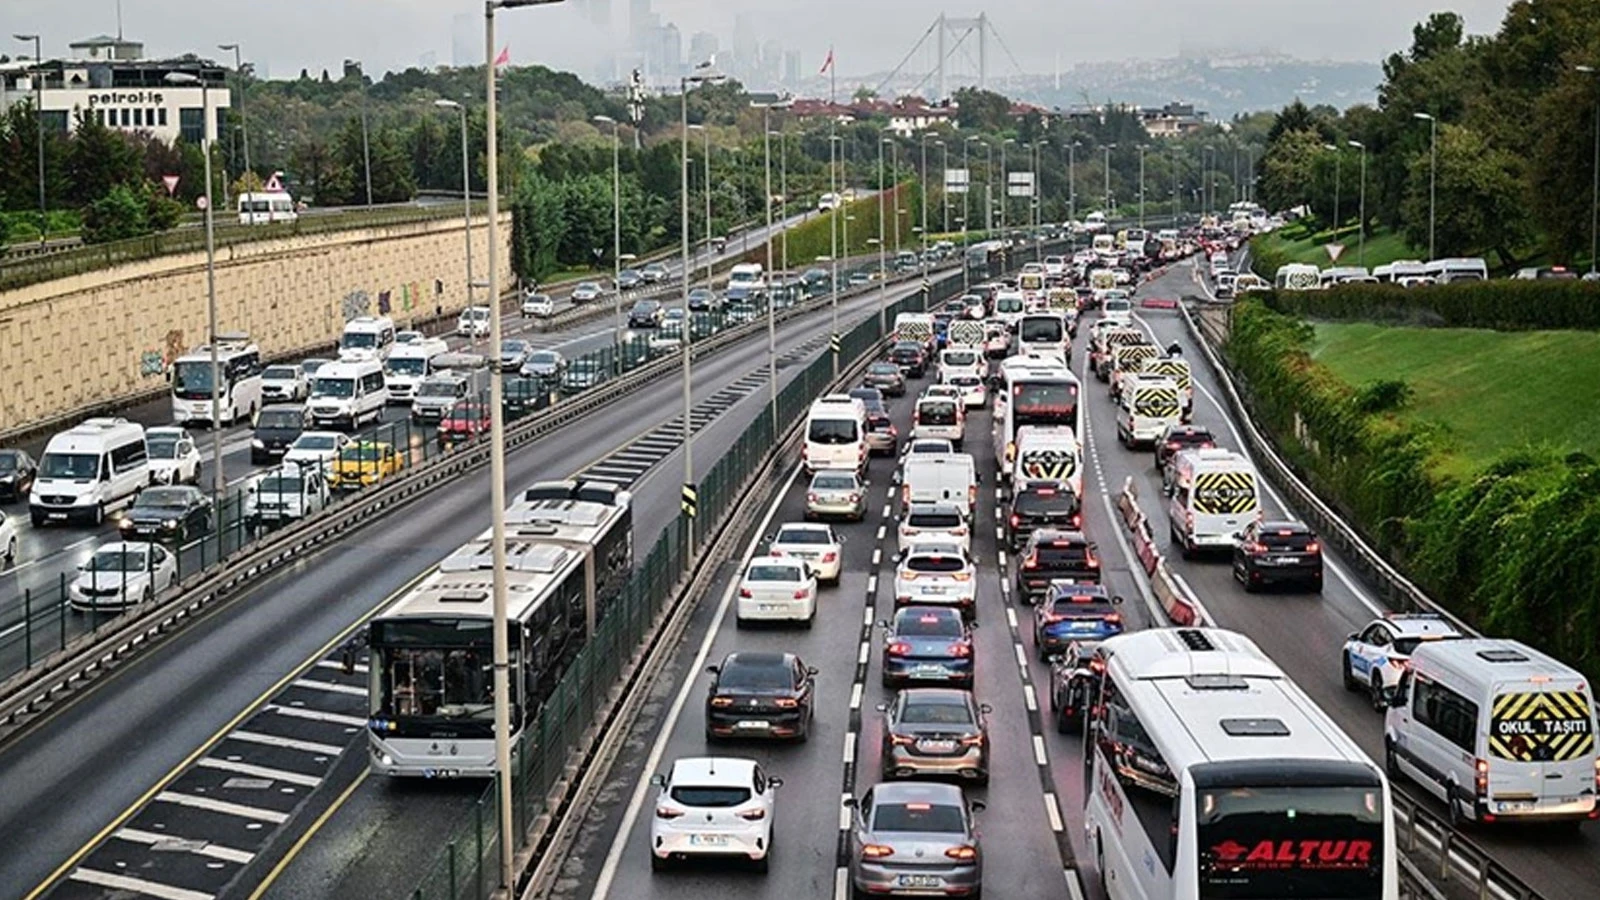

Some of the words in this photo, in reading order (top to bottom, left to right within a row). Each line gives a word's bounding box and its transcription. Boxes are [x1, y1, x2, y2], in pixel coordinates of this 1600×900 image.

[1499, 721, 1536, 734] OKUL
[1544, 721, 1587, 734] TAŞITI
[1246, 840, 1372, 861] ALTUR
